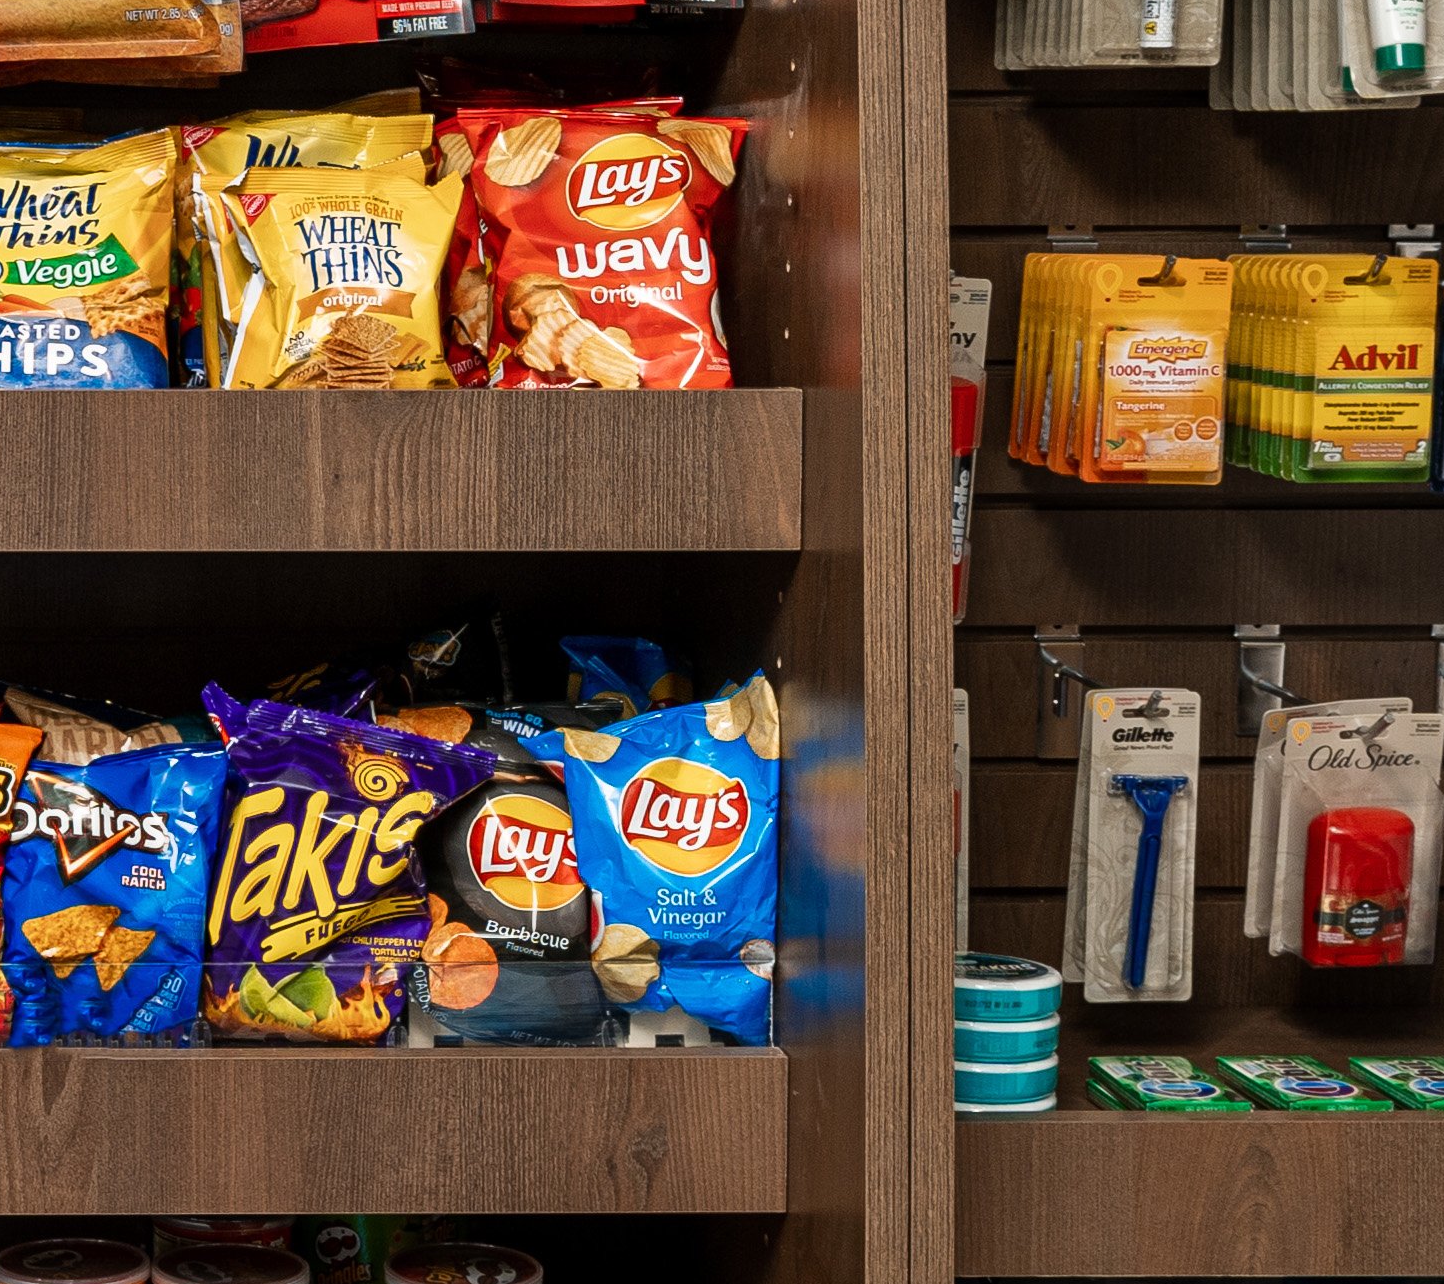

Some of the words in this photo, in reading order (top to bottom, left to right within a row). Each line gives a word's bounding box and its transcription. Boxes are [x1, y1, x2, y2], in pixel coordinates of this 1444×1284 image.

[126, 10, 143, 21] NET
[146, 9, 159, 21] WT
[577, 155, 684, 208] Lay's
[317, 199, 360, 214] WHOLE
[362, 202, 404, 222] GRAIN
[556, 227, 711, 285] wavy
[15, 250, 119, 288] Veggie
[1133, 342, 1206, 360] Emergen-C
[1329, 344, 1420, 371] Advil
[1116, 400, 1165, 414] Tangerine
[1112, 727, 1174, 743] Gillette
[1308, 744, 1354, 772] Old
[1356, 744, 1419, 769] Spice
[208, 786, 432, 944] Takis
[656, 889, 697, 907] Salt
[702, 891, 717, 905] &
[649, 907, 727, 928] Vinegar
[486, 919, 570, 951] Barbecue
